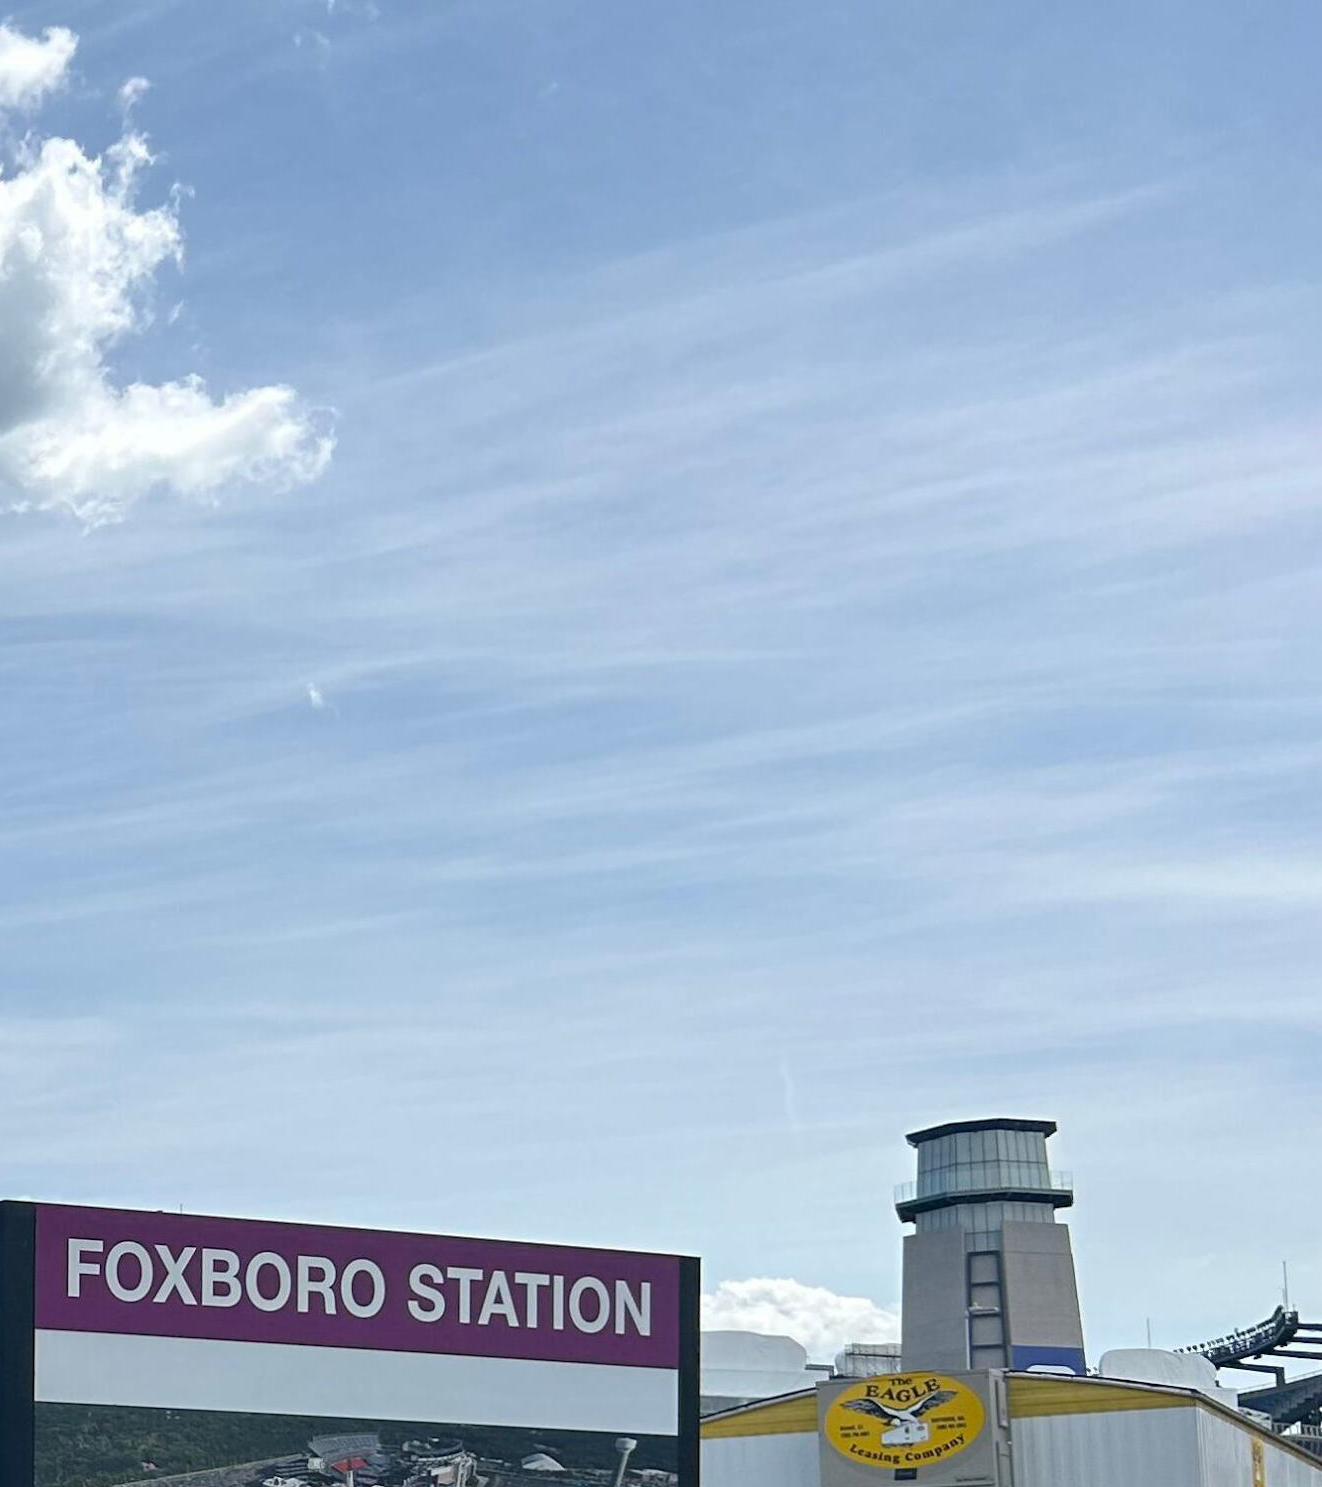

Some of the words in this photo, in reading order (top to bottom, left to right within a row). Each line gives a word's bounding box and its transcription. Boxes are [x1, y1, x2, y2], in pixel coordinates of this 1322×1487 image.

[67, 1238, 386, 1319] FOXBORO
[407, 1263, 652, 1336] STATION
[865, 1378, 941, 1402] EAGLE
[889, 1378, 913, 1386] The
[849, 1443, 901, 1464] Leasing
[905, 1433, 965, 1462] Company
